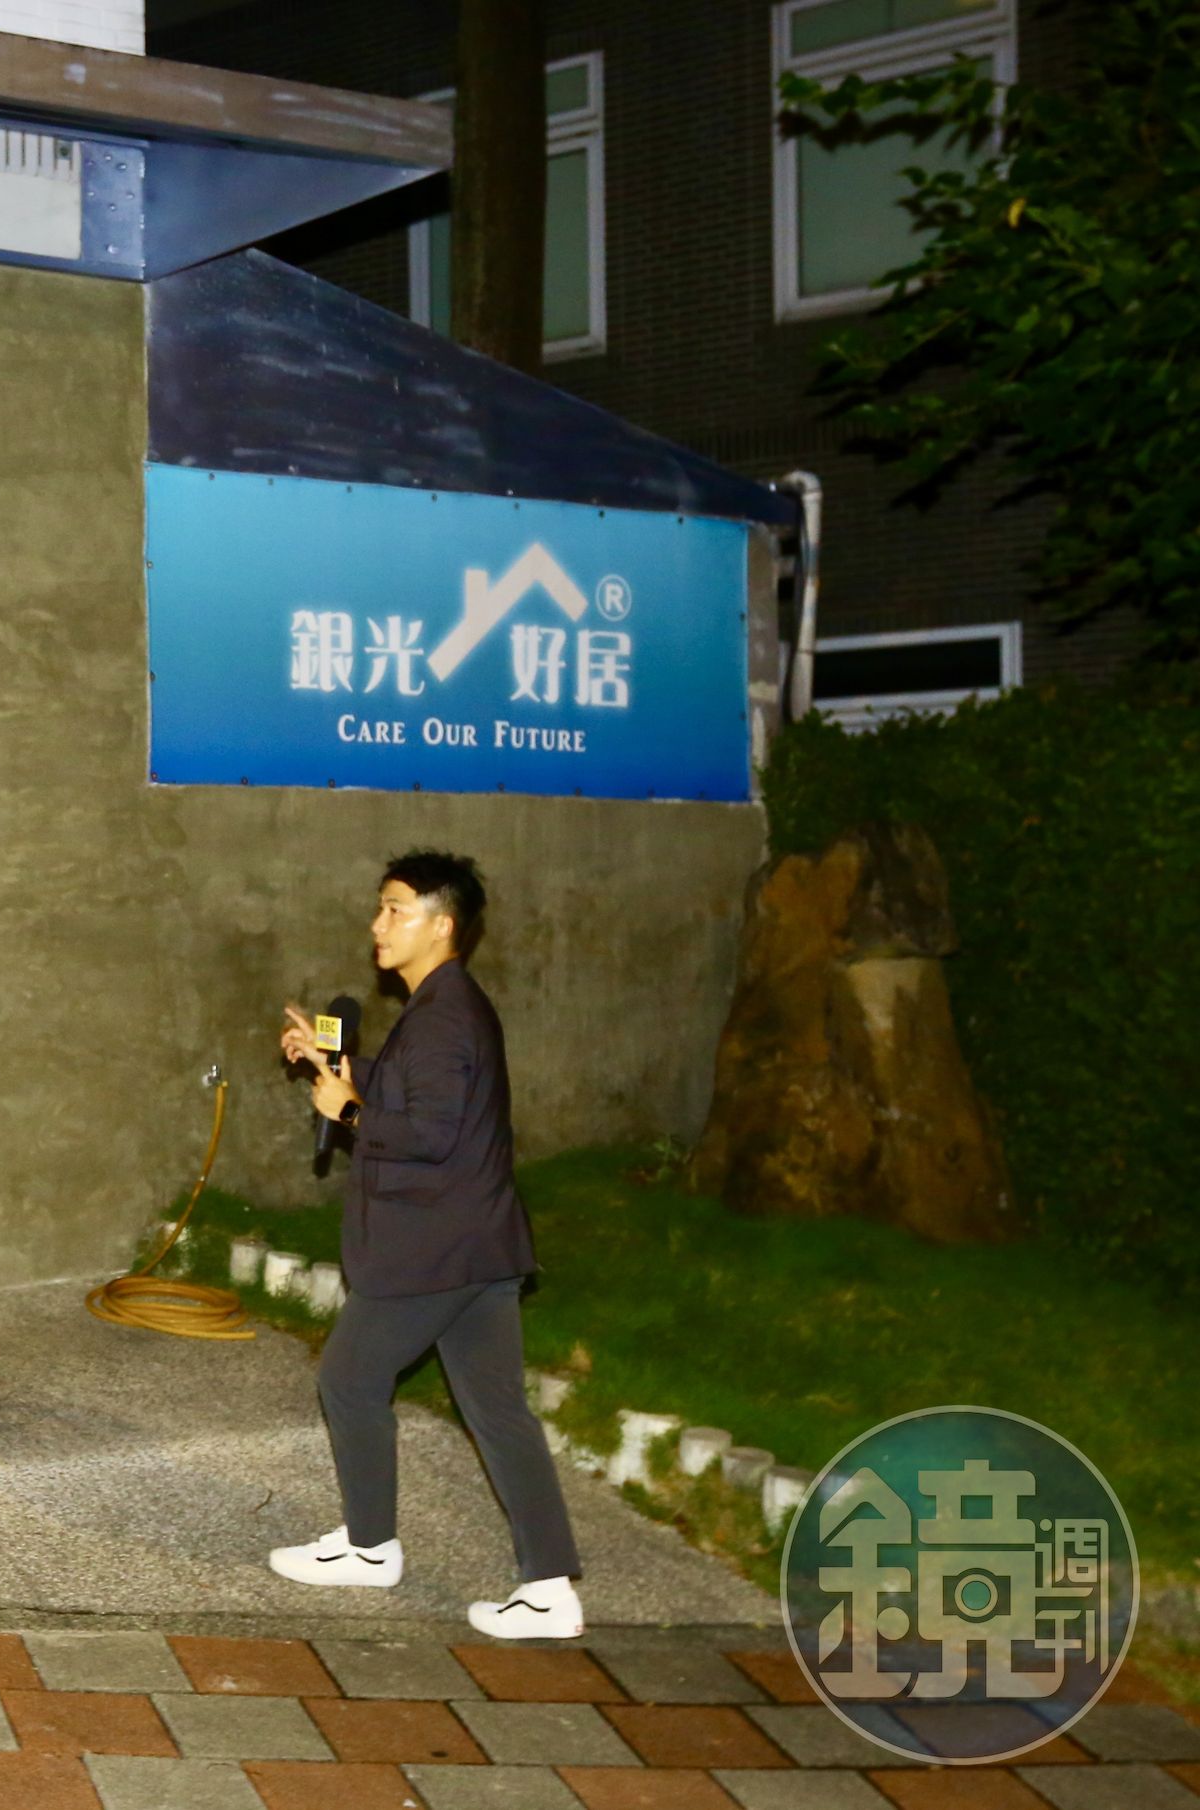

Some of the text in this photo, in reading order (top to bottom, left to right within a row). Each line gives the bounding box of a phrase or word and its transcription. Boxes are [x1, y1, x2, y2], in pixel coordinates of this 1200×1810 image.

[337, 714, 586, 753] CARE OUR FUTURE
